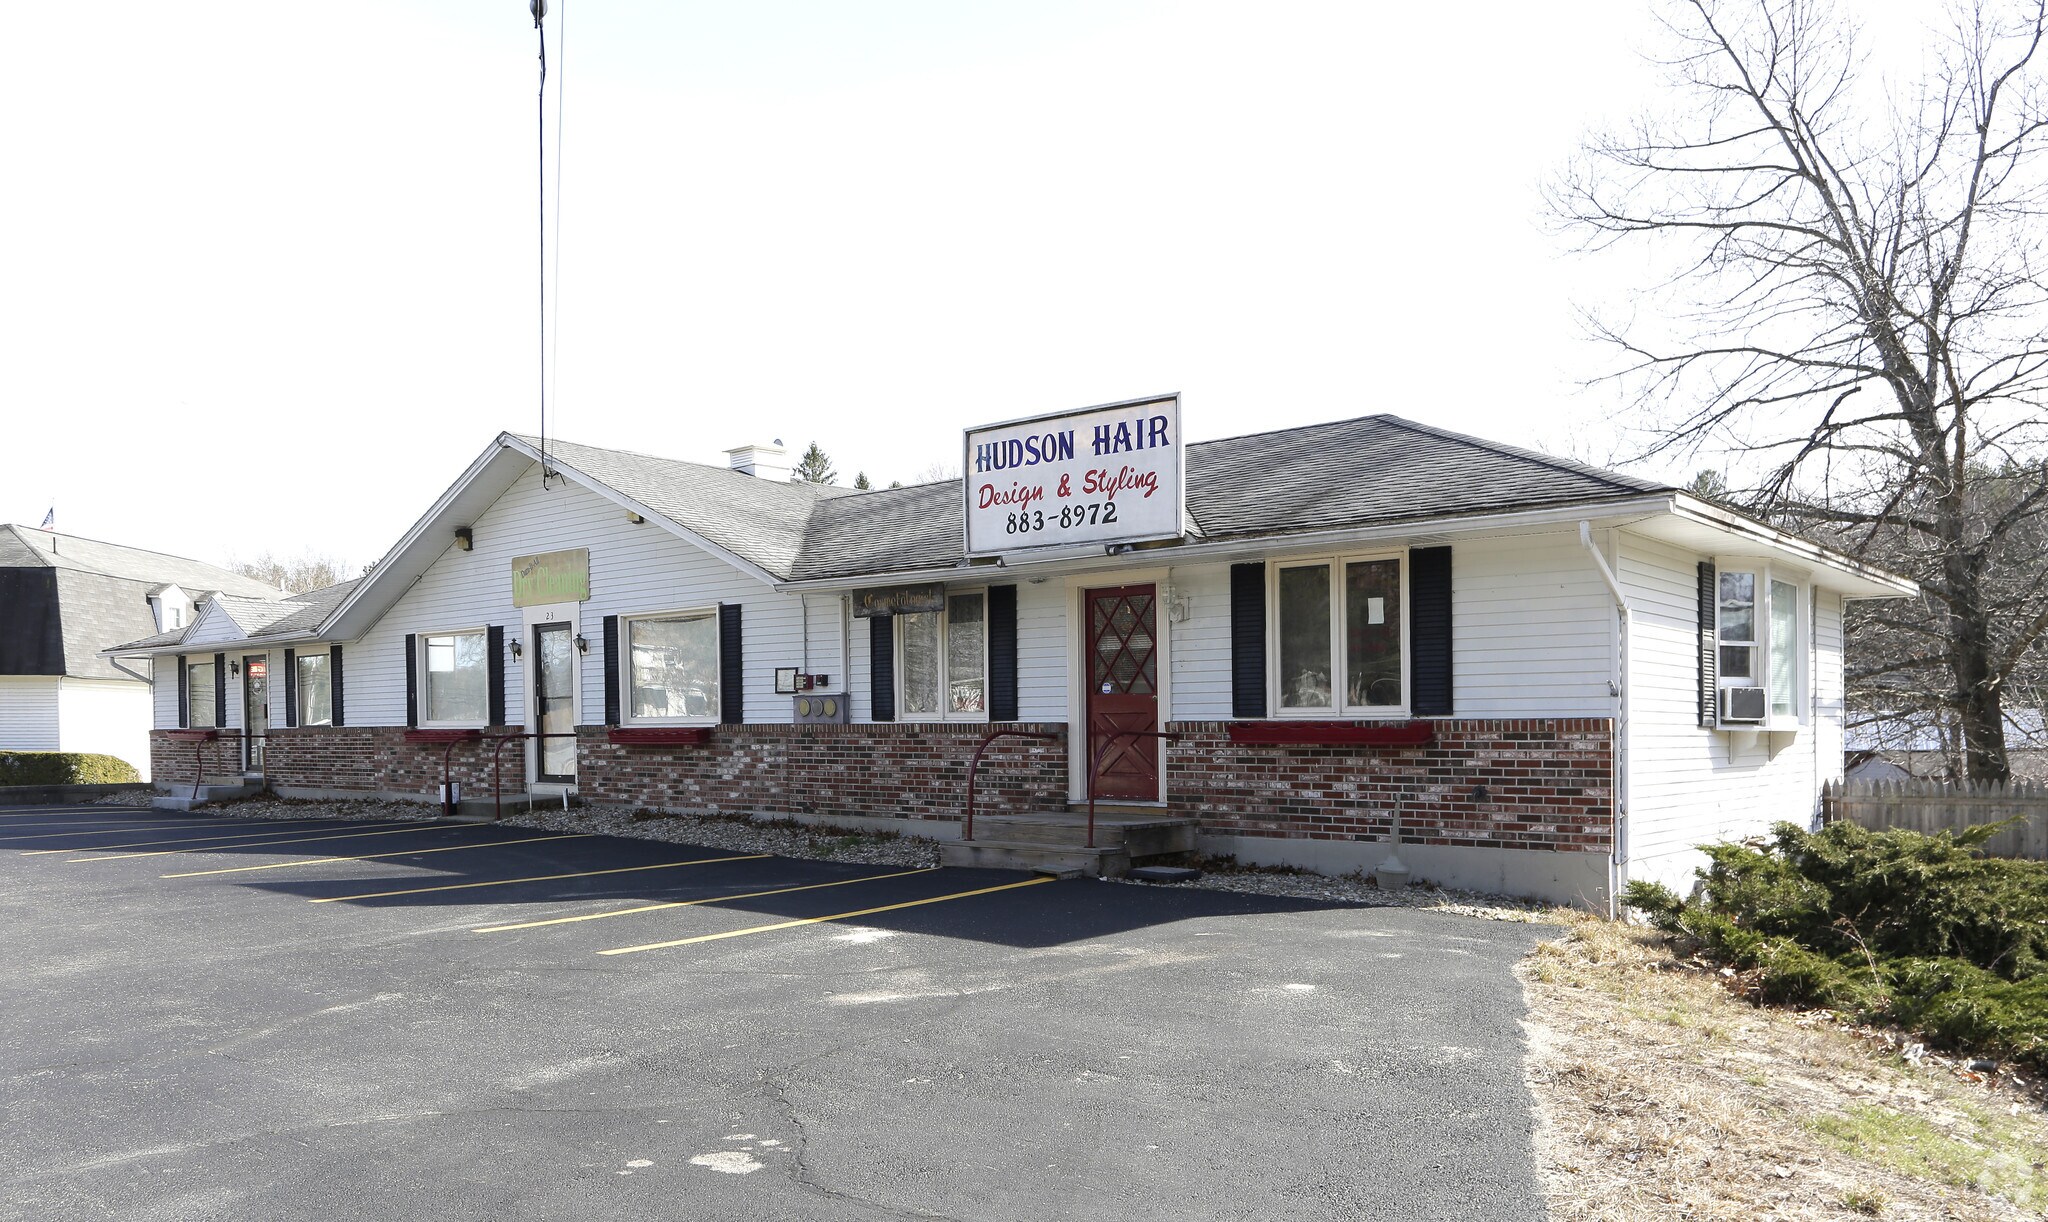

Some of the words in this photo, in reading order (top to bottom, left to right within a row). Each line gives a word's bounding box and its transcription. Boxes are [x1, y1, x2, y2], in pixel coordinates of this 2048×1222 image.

[976, 430, 1075, 473] HUDSON
[1092, 415, 1170, 456] HAIR
[978, 481, 1044, 511] Design
[1057, 473, 1072, 498] &
[1082, 465, 1159, 501] Styling
[1006, 501, 1118, 535] 883-8972
[536, 566, 587, 599] Cleaning
[546, 612, 554, 620] 23
